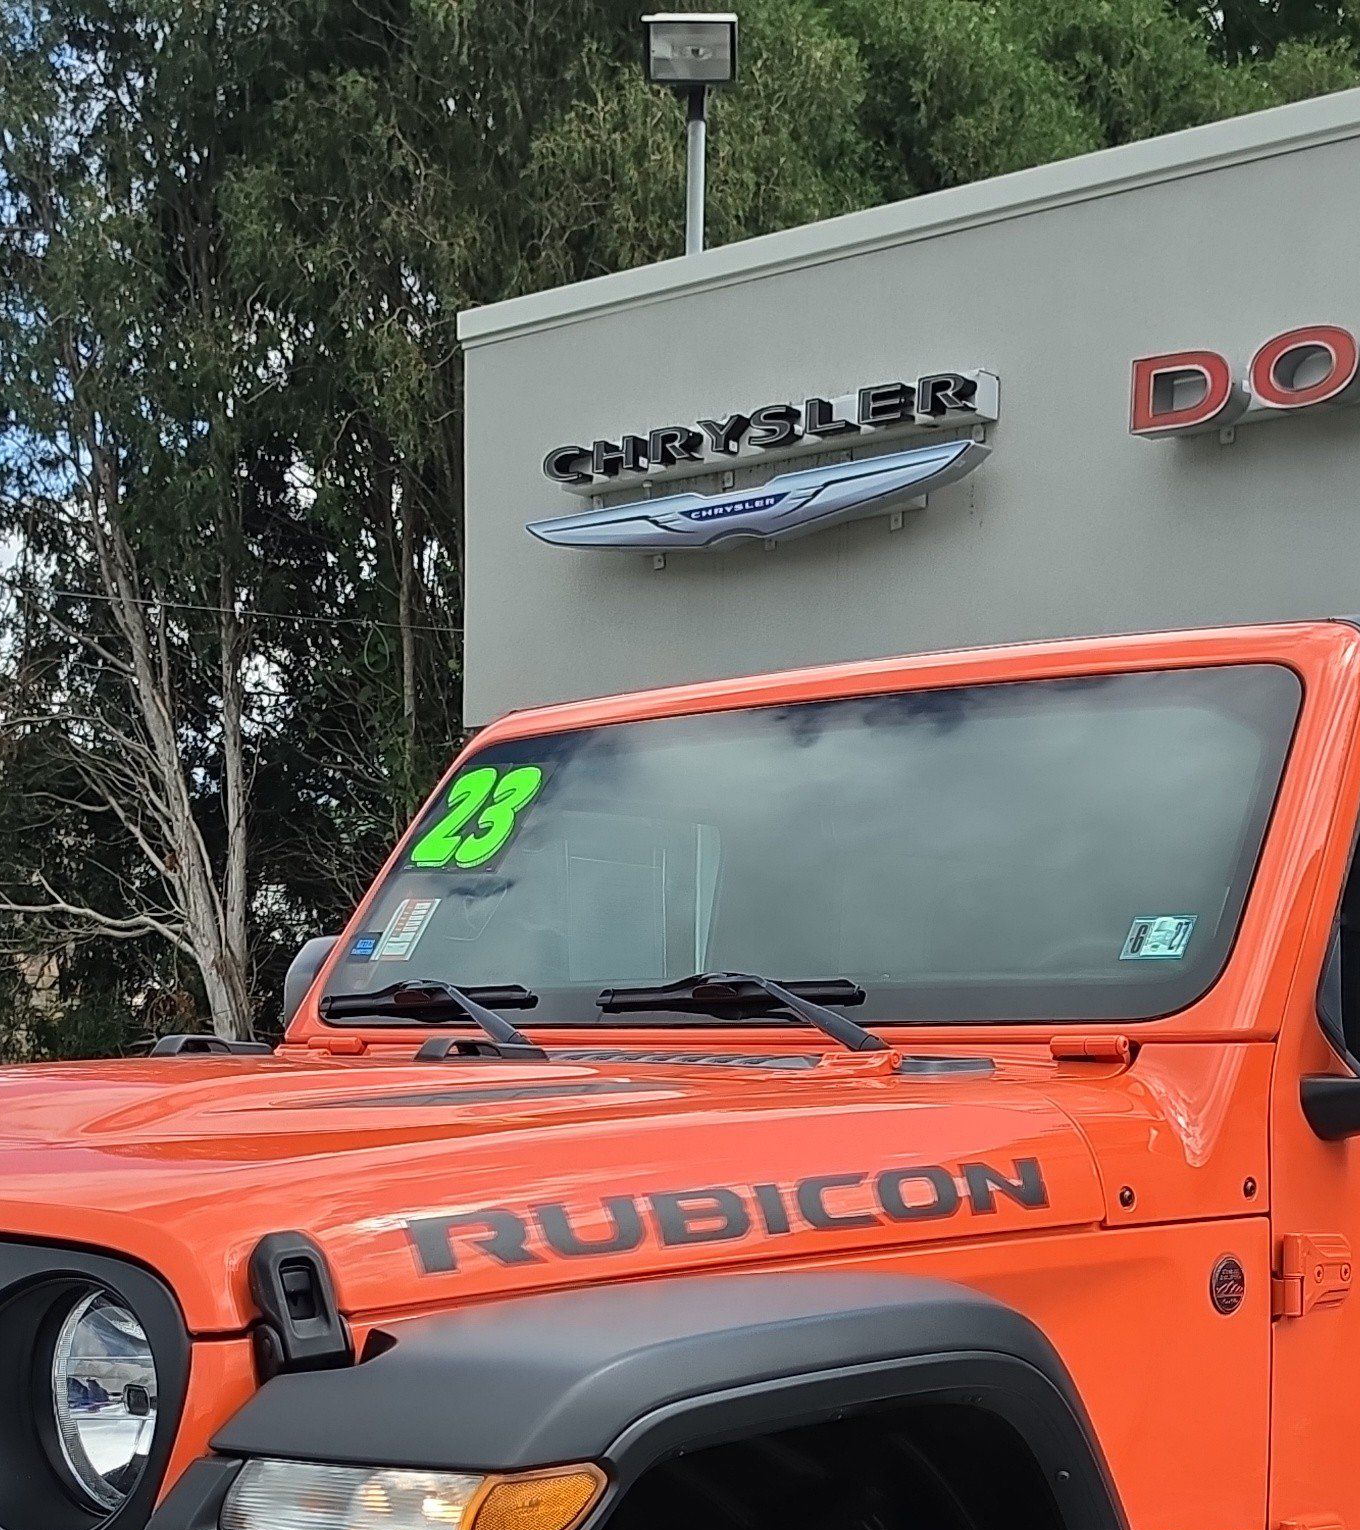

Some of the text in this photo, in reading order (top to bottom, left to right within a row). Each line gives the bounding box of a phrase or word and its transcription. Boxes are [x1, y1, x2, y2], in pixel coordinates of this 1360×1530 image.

[543, 372, 977, 484] CHRYSLER
[690, 497, 775, 519] CHRYSLER
[410, 766, 542, 868] 23
[406, 1156, 1051, 1277] RUBICON
